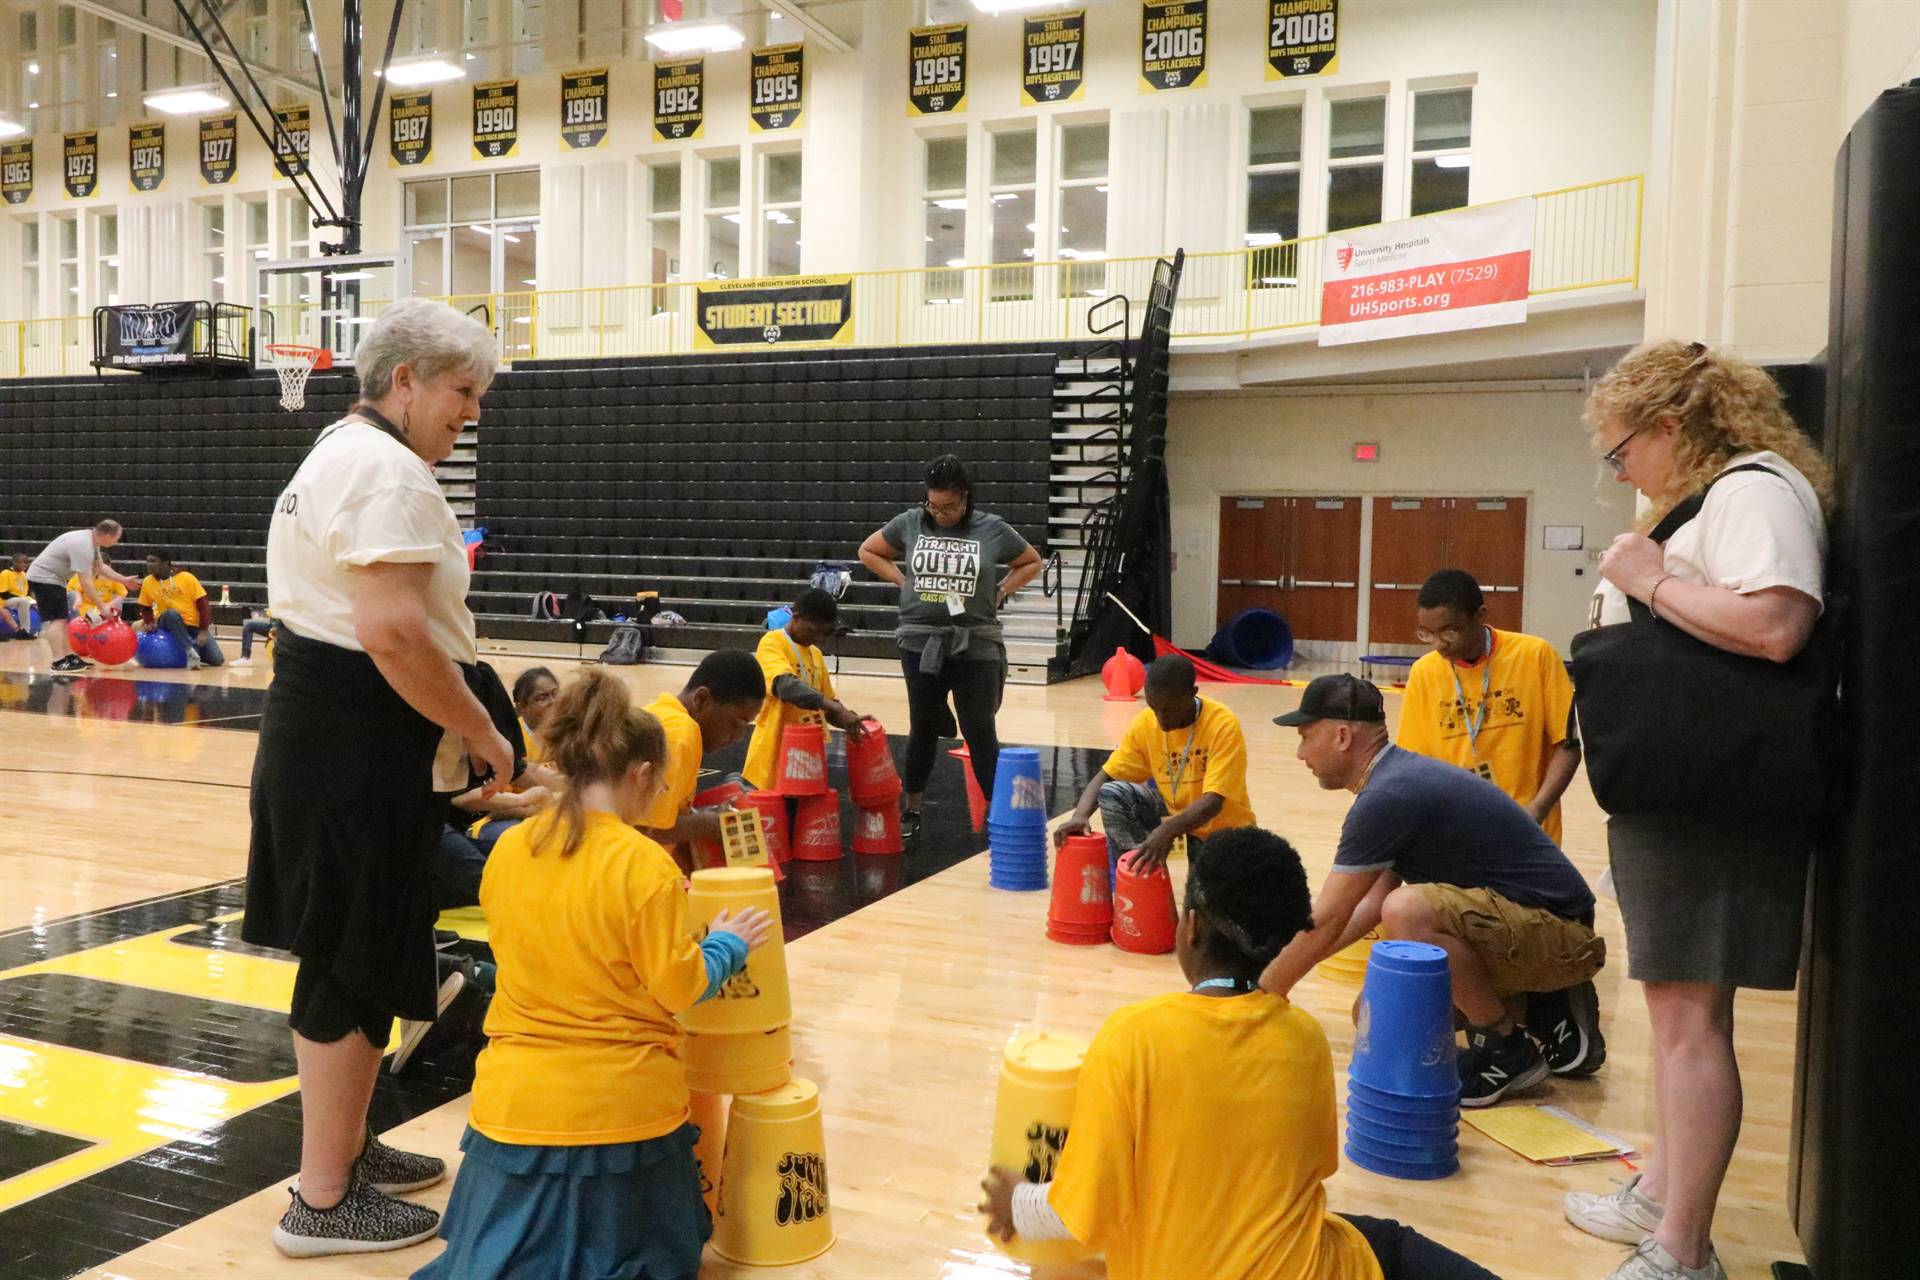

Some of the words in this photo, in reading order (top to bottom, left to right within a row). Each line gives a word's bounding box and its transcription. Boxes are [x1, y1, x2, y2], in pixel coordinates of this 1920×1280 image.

[1165, 6, 1184, 16] STATE
[1274, 0, 1333, 16] CHAMPIONS
[1044, 20, 1064, 31] STATE
[1148, 14, 1202, 31] CHAMPIONS
[1271, 12, 1334, 47] 2008
[929, 34, 948, 45] STATE
[1028, 28, 1080, 46] CHAMPIONS
[1145, 28, 1203, 60] 2006
[914, 42, 962, 59] CHAMPIONS
[1029, 42, 1078, 74] 1997
[1270, 48, 1286, 57] BOYS
[1287, 46, 1305, 56] TRACK
[1306, 45, 1318, 54] AND
[1319, 43, 1334, 52] FIELD
[768, 55, 784, 64] STATE
[1146, 60, 1166, 71] GIRLS
[1166, 57, 1201, 69] LACROSSE
[756, 62, 798, 78] CHAMPIONS
[915, 56, 960, 86] 1995
[1026, 75, 1042, 85] BOYS
[1043, 70, 1080, 83] BASKETBALL
[578, 78, 592, 87] STATE
[658, 74, 700, 89] CHAMPIONS
[756, 75, 798, 103] 1995
[913, 85, 930, 96] BOYS
[931, 82, 962, 94] LACROSSE
[565, 85, 604, 99] CHAMPIONS
[659, 86, 698, 114] 1992
[477, 96, 514, 110] CHAMPIONS
[567, 97, 602, 124] 1991
[394, 105, 428, 119] CHAMPIONS
[477, 107, 514, 134] 1990
[394, 117, 428, 142] 1987
[133, 147, 162, 170] 1976
[204, 139, 232, 162] 1977
[4, 162, 30, 184] 1965
[68, 154, 94, 177] 1973
[1354, 245, 1392, 257] University
[1394, 237, 1430, 250] Hospitals
[720, 282, 756, 290] CLEVELAND
[758, 280, 783, 288] HEIGHTS
[1350, 272, 1446, 298] 216-983-PLAY
[1450, 264, 1498, 286] (7529)
[1350, 292, 1450, 316] UHSports.org
[706, 303, 775, 330] STUDENT
[776, 299, 842, 326] SECTION
[918, 539, 976, 552] STRAIGHT
[914, 552, 976, 577] OUTTA
[914, 576, 973, 593] HEIGHTS
[920, 592, 938, 602] CLASS
